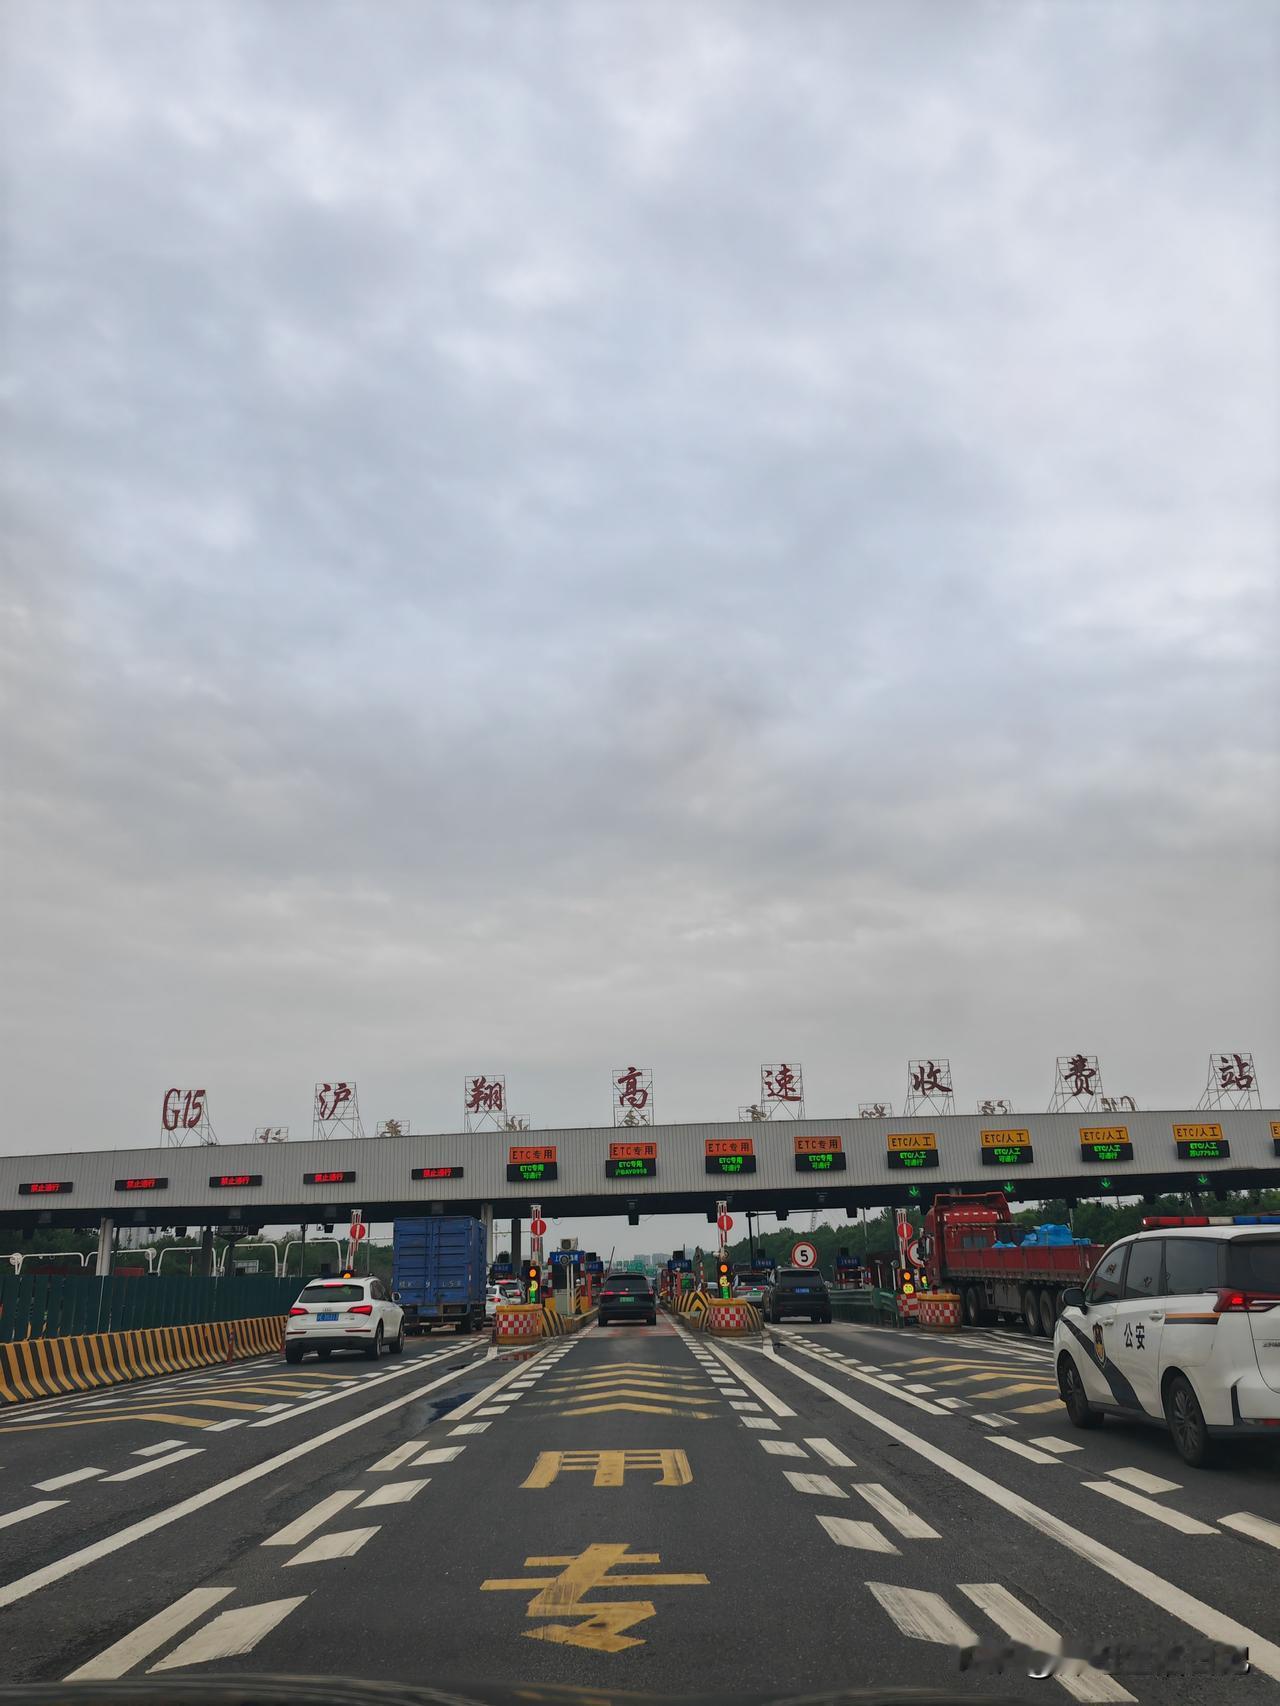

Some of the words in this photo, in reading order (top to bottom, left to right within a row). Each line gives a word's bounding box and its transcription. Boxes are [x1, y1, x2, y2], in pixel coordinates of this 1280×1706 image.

[984, 1132, 1025, 1143] ETC/人工
[1083, 1129, 1126, 1141] ETC/人工
[1176, 1126, 1219, 1138] ETC/人工
[708, 1142, 749, 1152] ETC专用
[797, 1139, 838, 1149] ETC专用
[891, 1137, 932, 1147] ETC/人工
[512, 1149, 552, 1160] ETC专用
[613, 1145, 654, 1156] ETC专用
[800, 1250, 809, 1262] 5
[1124, 1322, 1145, 1350] 公安
